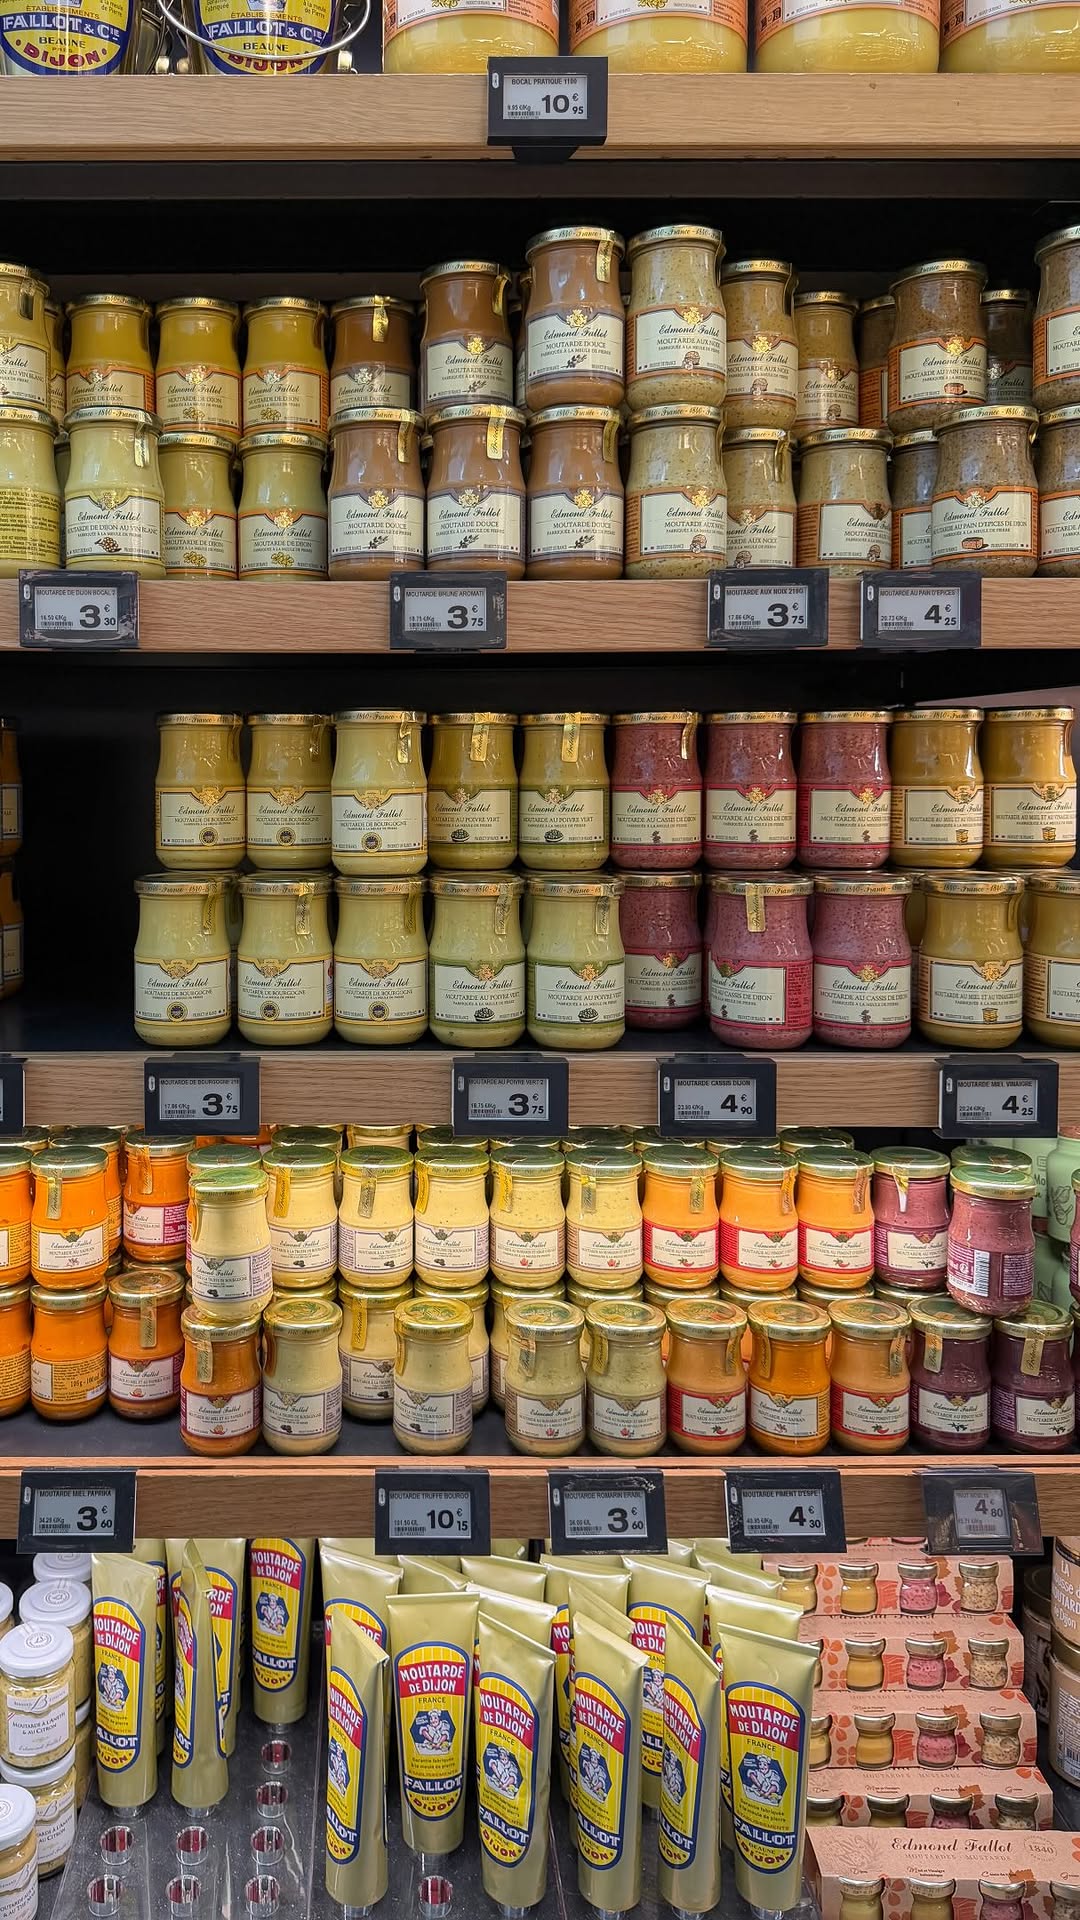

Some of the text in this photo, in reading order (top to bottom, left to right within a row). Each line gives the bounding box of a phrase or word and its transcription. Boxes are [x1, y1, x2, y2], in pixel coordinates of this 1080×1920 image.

[3, 15, 82, 31] FALLOT
[84, 24, 94, 34] &
[208, 20, 286, 38] FALLOT
[286, 27, 297, 37] &
[39, 36, 86, 48] BEAUNE
[243, 42, 289, 52] BEAUNE
[23, 42, 101, 67] DIJON
[533, 79, 562, 87] PRATIQUE
[572, 93, 579, 102] €
[541, 94, 570, 114] 10
[572, 106, 584, 115] 95
[543, 327, 609, 340] Edmond Fallot
[658, 325, 694, 335] Edmond
[546, 341, 606, 349] MOUTARDE DOUCE
[77, 510, 140, 521] Edmond Fallot
[345, 508, 409, 520] Edmond Fallot
[943, 508, 1010, 521] Edmond Fallot
[726, 589, 759, 597] MOUTARDE
[104, 604, 111, 612] €
[472, 604, 478, 613] €
[792, 602, 799, 611] €
[945, 604, 952, 613] €
[80, 604, 101, 628] 3
[447, 605, 468, 629] 3
[767, 602, 789, 627] 3
[792, 616, 804, 624] 75
[924, 604, 942, 624] 4
[104, 617, 116, 626] 30
[471, 618, 483, 626] 75
[944, 617, 957, 626] 25
[723, 803, 755, 811] Edmond
[342, 809, 372, 818] Edmond
[147, 979, 179, 988] Edmond
[452, 980, 485, 989] Edmond
[832, 980, 869, 991] Edmond
[226, 1092, 233, 1101] €
[532, 1093, 539, 1102] €
[740, 1094, 747, 1102] €
[1022, 1094, 1029, 1103] €
[202, 1093, 224, 1116] 3
[226, 1105, 238, 1114] 75
[508, 1093, 530, 1116] 3
[720, 1094, 738, 1113] 4
[1001, 1095, 1019, 1114] 4
[532, 1106, 544, 1114] 75
[740, 1106, 752, 1115] 90
[1021, 1107, 1034, 1116] 25
[101, 1505, 108, 1514] €
[457, 1508, 463, 1516] €
[631, 1507, 638, 1515] €
[808, 1505, 815, 1514] €
[975, 1499, 1003, 1517] 4 80
[77, 1506, 98, 1532] 3
[426, 1509, 454, 1529] 10
[608, 1508, 629, 1533] 3
[789, 1506, 806, 1526] 4
[100, 1519, 112, 1528] 60
[457, 1520, 468, 1531] 15
[632, 1521, 644, 1530] 60
[809, 1519, 821, 1528] 30
[251, 1551, 300, 1574] MOUTARDE
[266, 1565, 292, 1583] DIJON
[1061, 1560, 1070, 1578] LA
[105, 1633, 131, 1655] DIJON
[399, 1664, 465, 1682] MOUTARDE
[408, 1679, 456, 1694] DE DIJON
[418, 1696, 446, 1704] FRANCE
[480, 1693, 533, 1730] MOUTARDE
[729, 1703, 799, 1732] MOUTARDE
[483, 1710, 525, 1739] DE DIJON
[489, 1729, 515, 1745] FRANCE
[738, 1720, 788, 1744] DE DIJON
[746, 1739, 776, 1752] FRANCE
[404, 1774, 463, 1791] FALLOT
[415, 1797, 454, 1811] DIJON
[734, 1818, 796, 1845] FALLOT
[482, 1829, 517, 1857] DIJON
[891, 1837, 1055, 1855] Edmond Fallot 1840
[741, 1841, 785, 1863] DIJON
